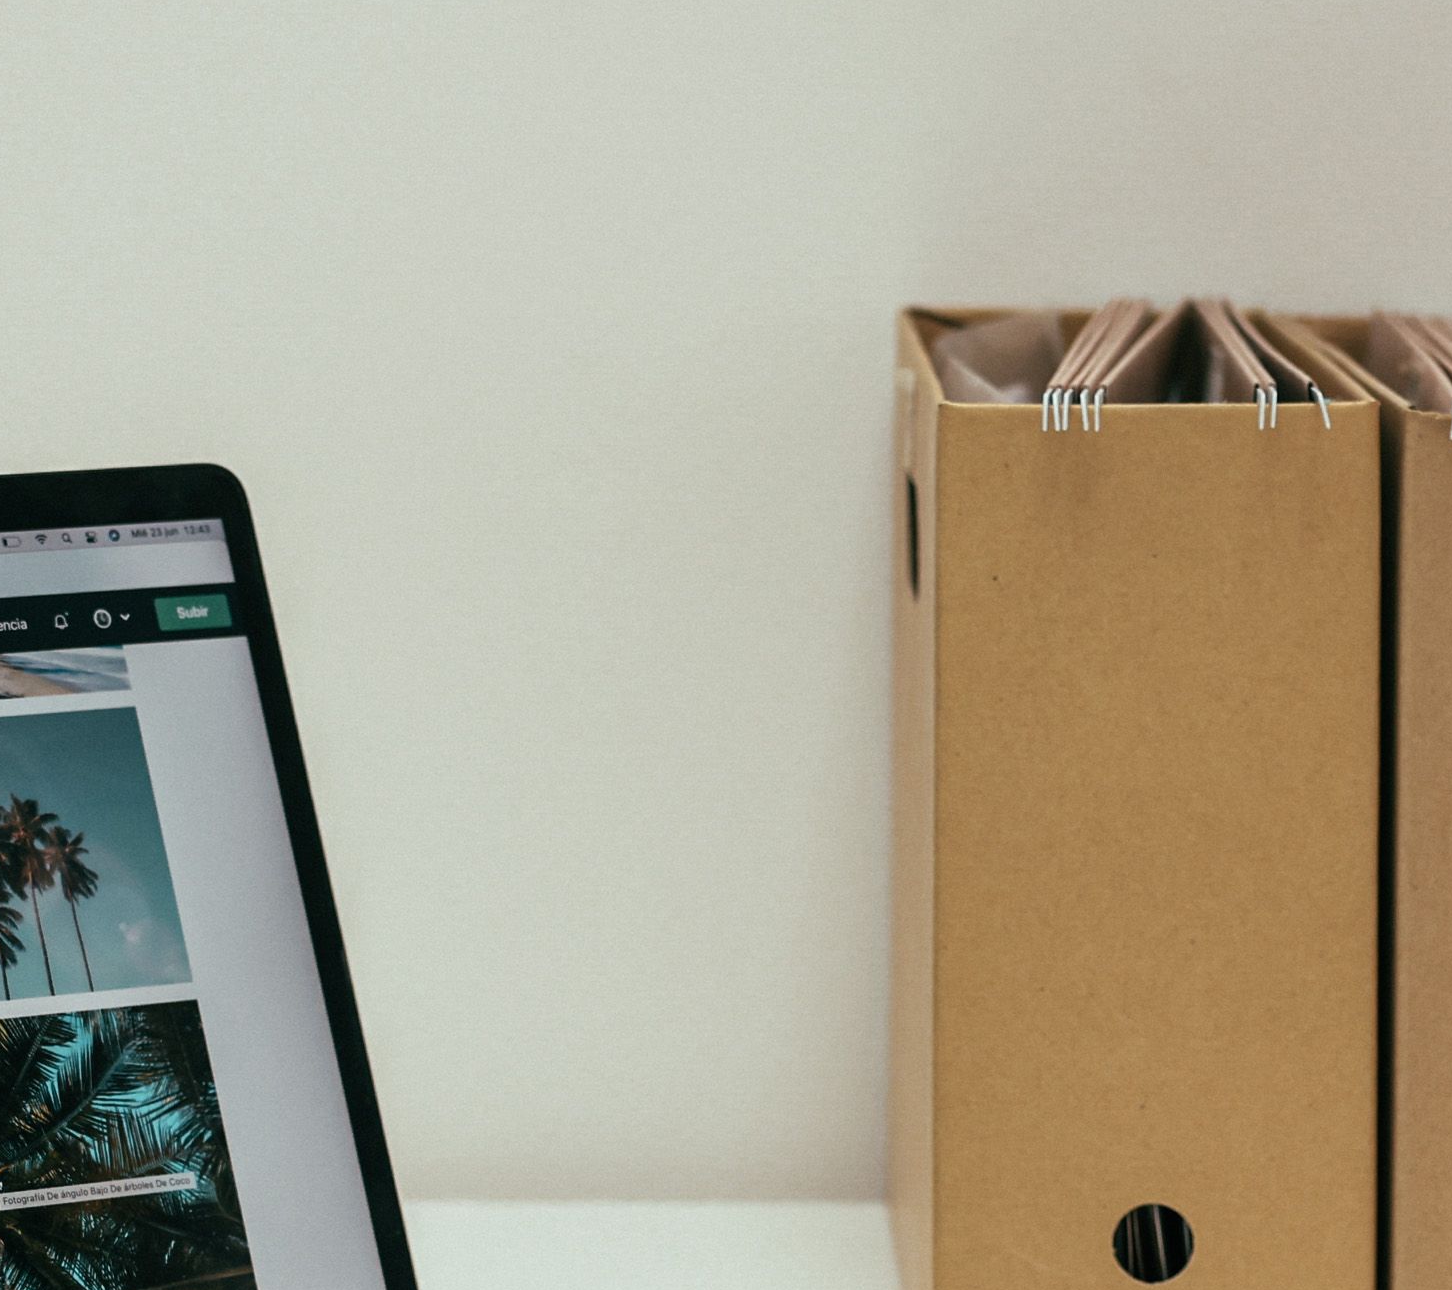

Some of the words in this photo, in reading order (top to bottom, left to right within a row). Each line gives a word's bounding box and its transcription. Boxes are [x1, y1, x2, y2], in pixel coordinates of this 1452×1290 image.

[176, 605, 208, 619] Subir
[46, 1191, 60, 1201] De
[90, 1186, 108, 1195] Bajo
[110, 1184, 122, 1193] De
[156, 1179, 167, 1187] De
[169, 1177, 190, 1187] Coco
